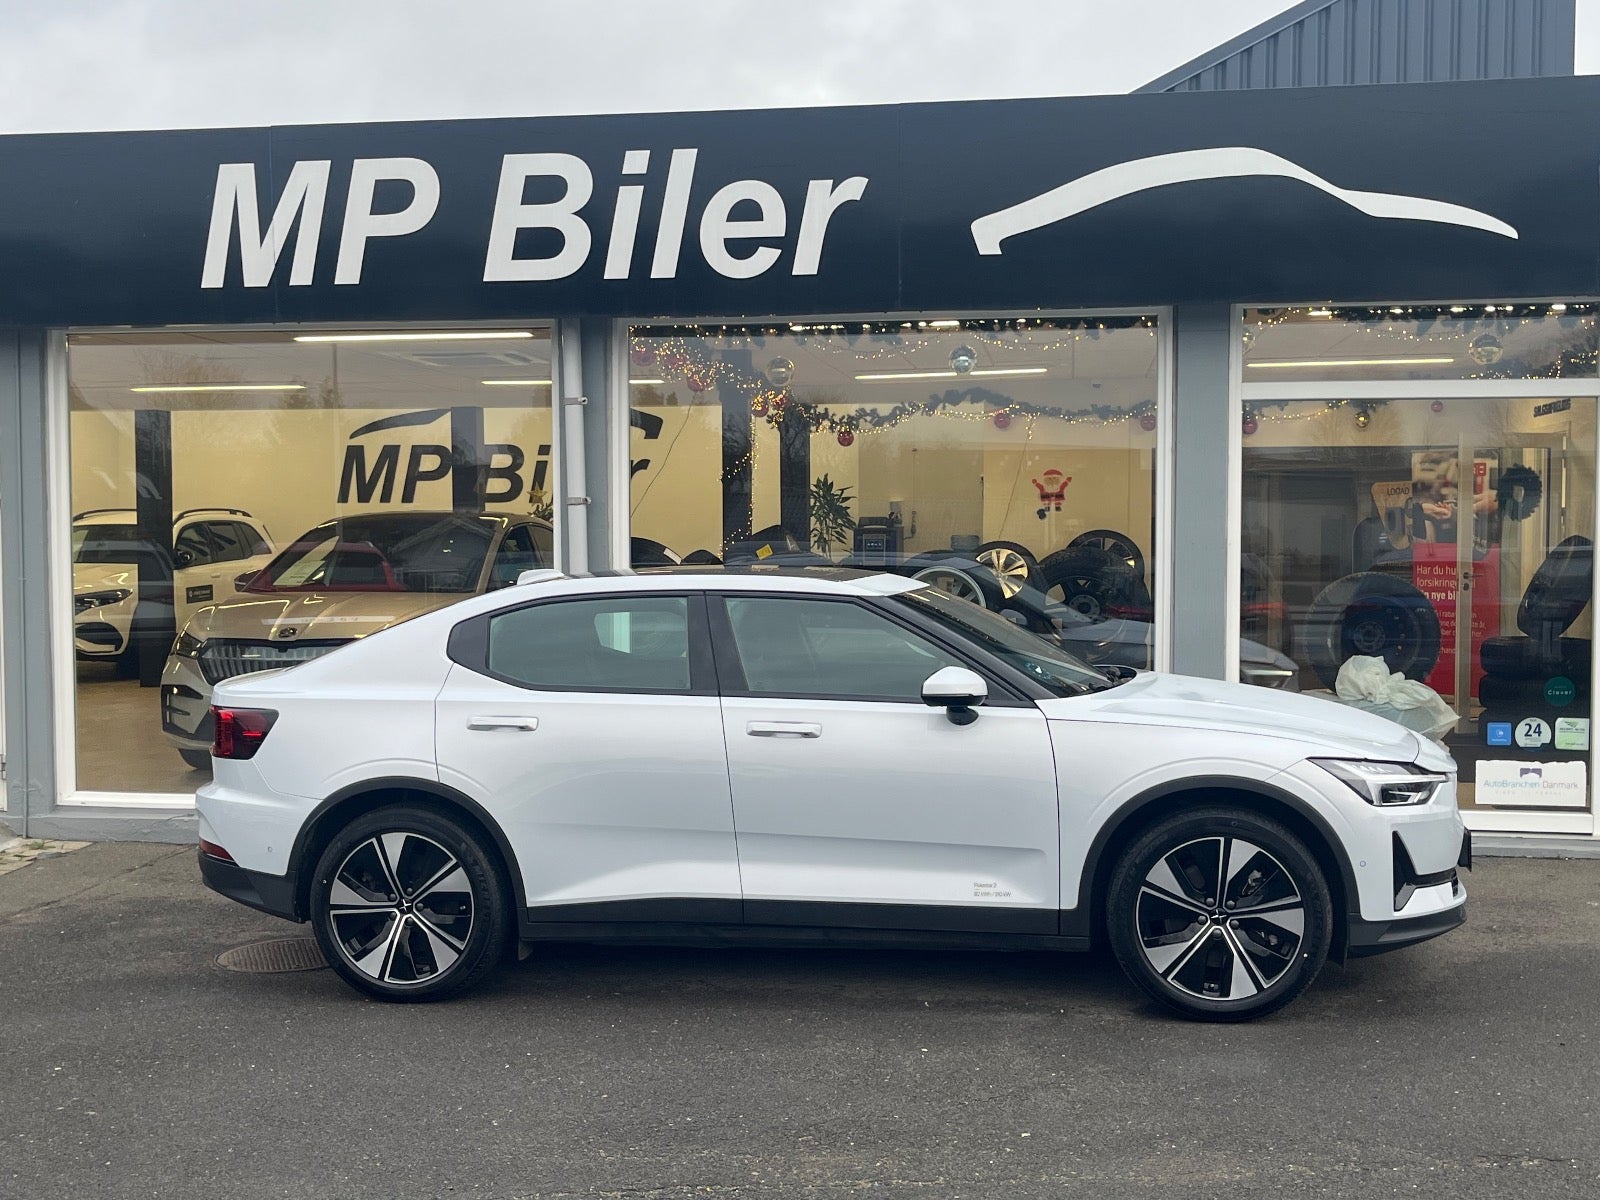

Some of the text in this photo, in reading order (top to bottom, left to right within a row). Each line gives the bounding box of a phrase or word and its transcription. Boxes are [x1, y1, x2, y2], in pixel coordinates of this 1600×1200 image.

[200, 148, 869, 289] MP Biler
[337, 444, 452, 503] MP
[1416, 564, 1431, 575] Har
[1432, 564, 1444, 575] du
[1431, 591, 1446, 602] nye
[1524, 723, 1542, 737] 24
[1483, 780, 1578, 789] AutoBranchen Danmark
